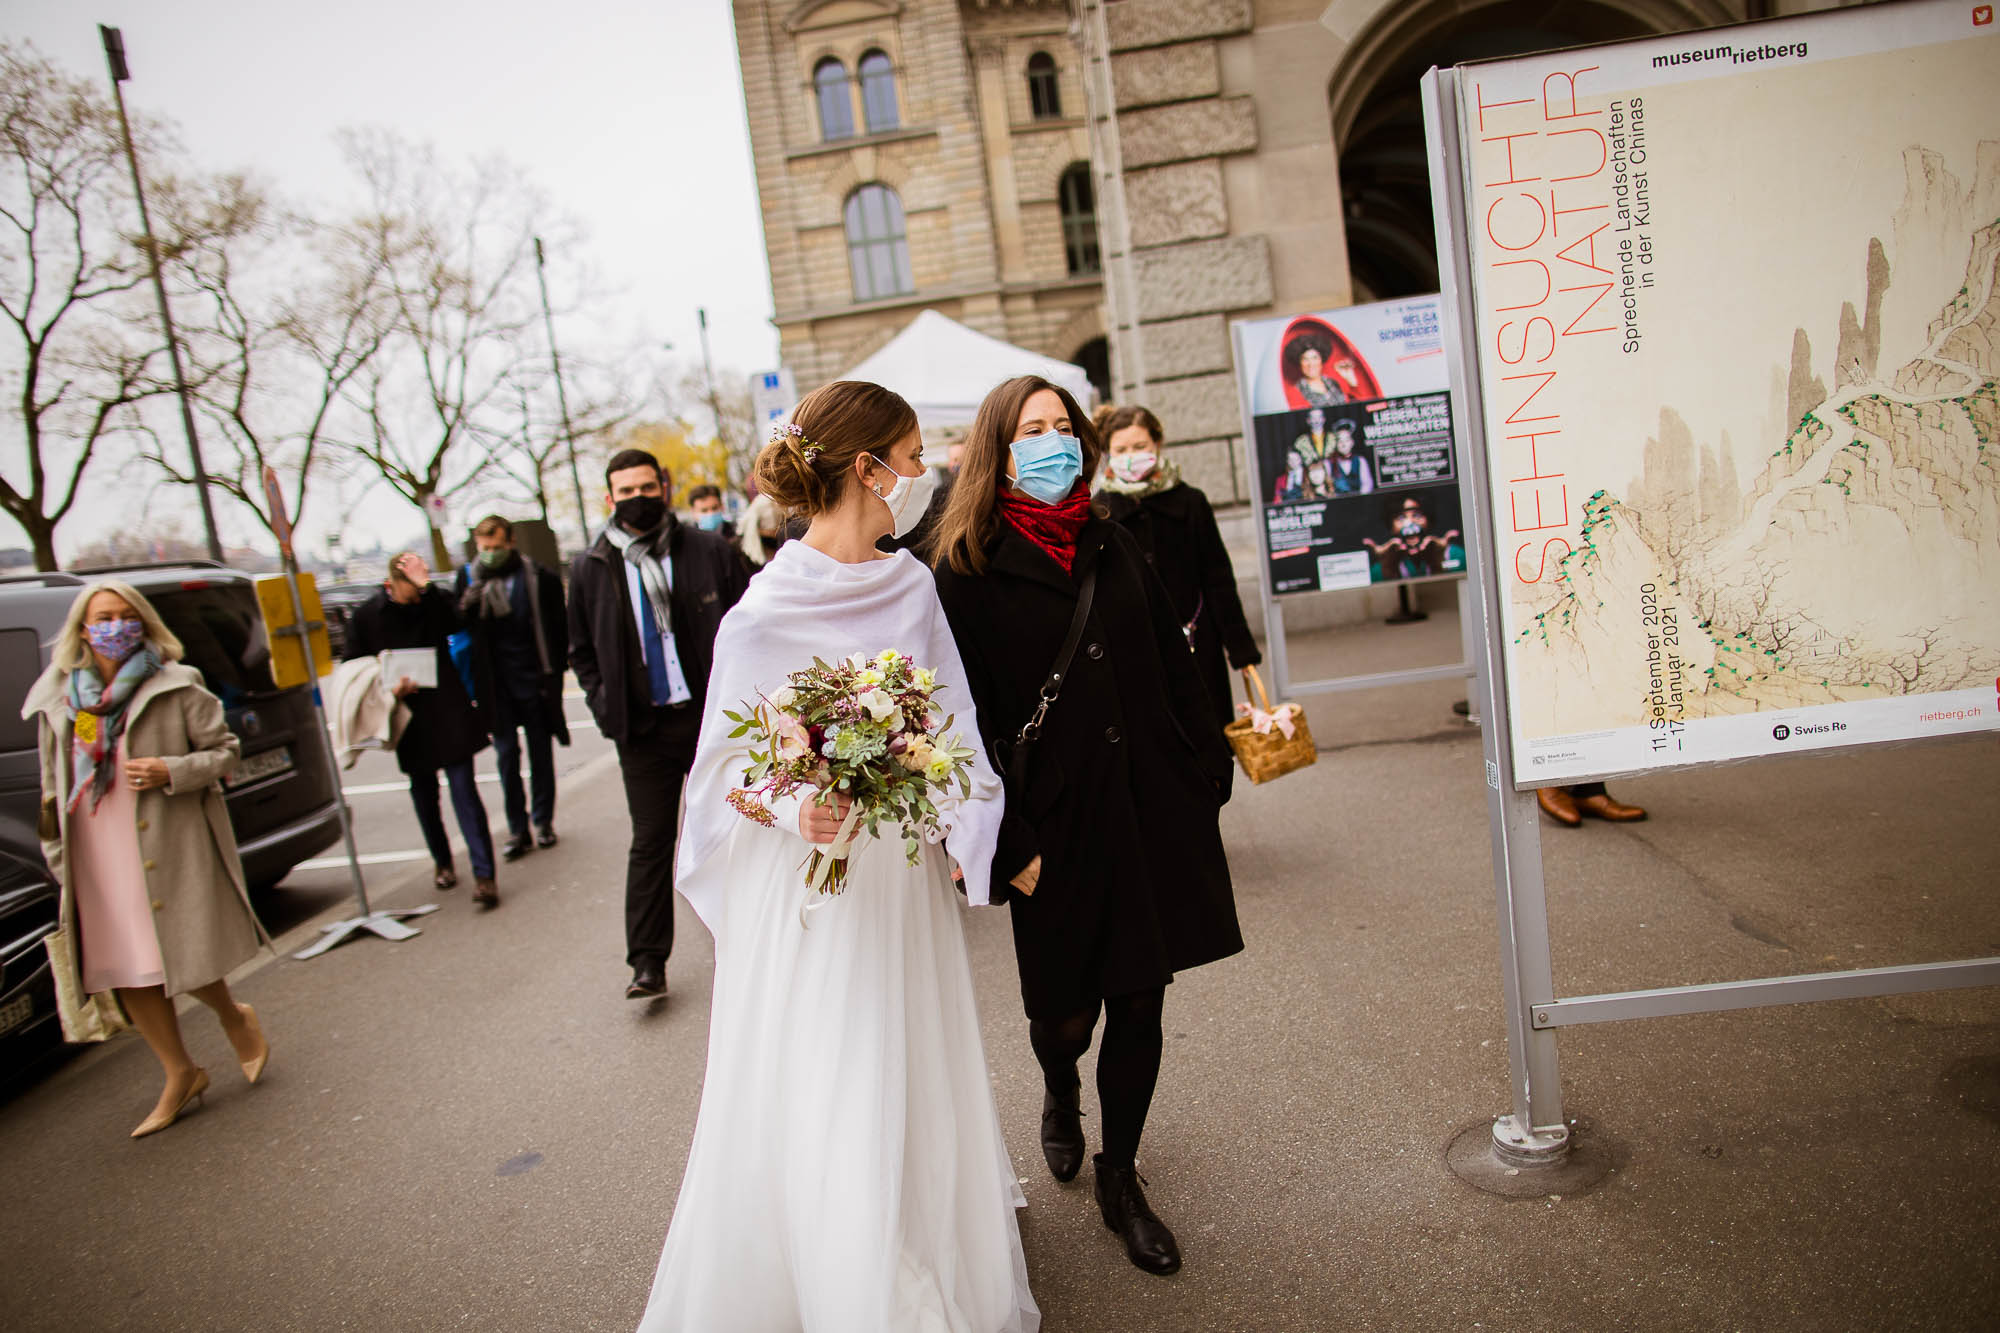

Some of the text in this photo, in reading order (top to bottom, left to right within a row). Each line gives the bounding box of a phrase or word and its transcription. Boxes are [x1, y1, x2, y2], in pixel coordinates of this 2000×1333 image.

[1543, 66, 1618, 337] NATUR
[1629, 97, 1655, 288] in der Kunst Chinas
[1608, 100, 1642, 353] Sprechende Landschaften
[1477, 83, 1572, 584] SEHNSUCHT
[1640, 583, 1659, 627] 2020
[1661, 606, 1680, 647] 2021
[1668, 652, 1684, 713] Januar
[1794, 721, 1847, 736] Swiss Re
[1919, 706, 1981, 722] rietberg.ch
